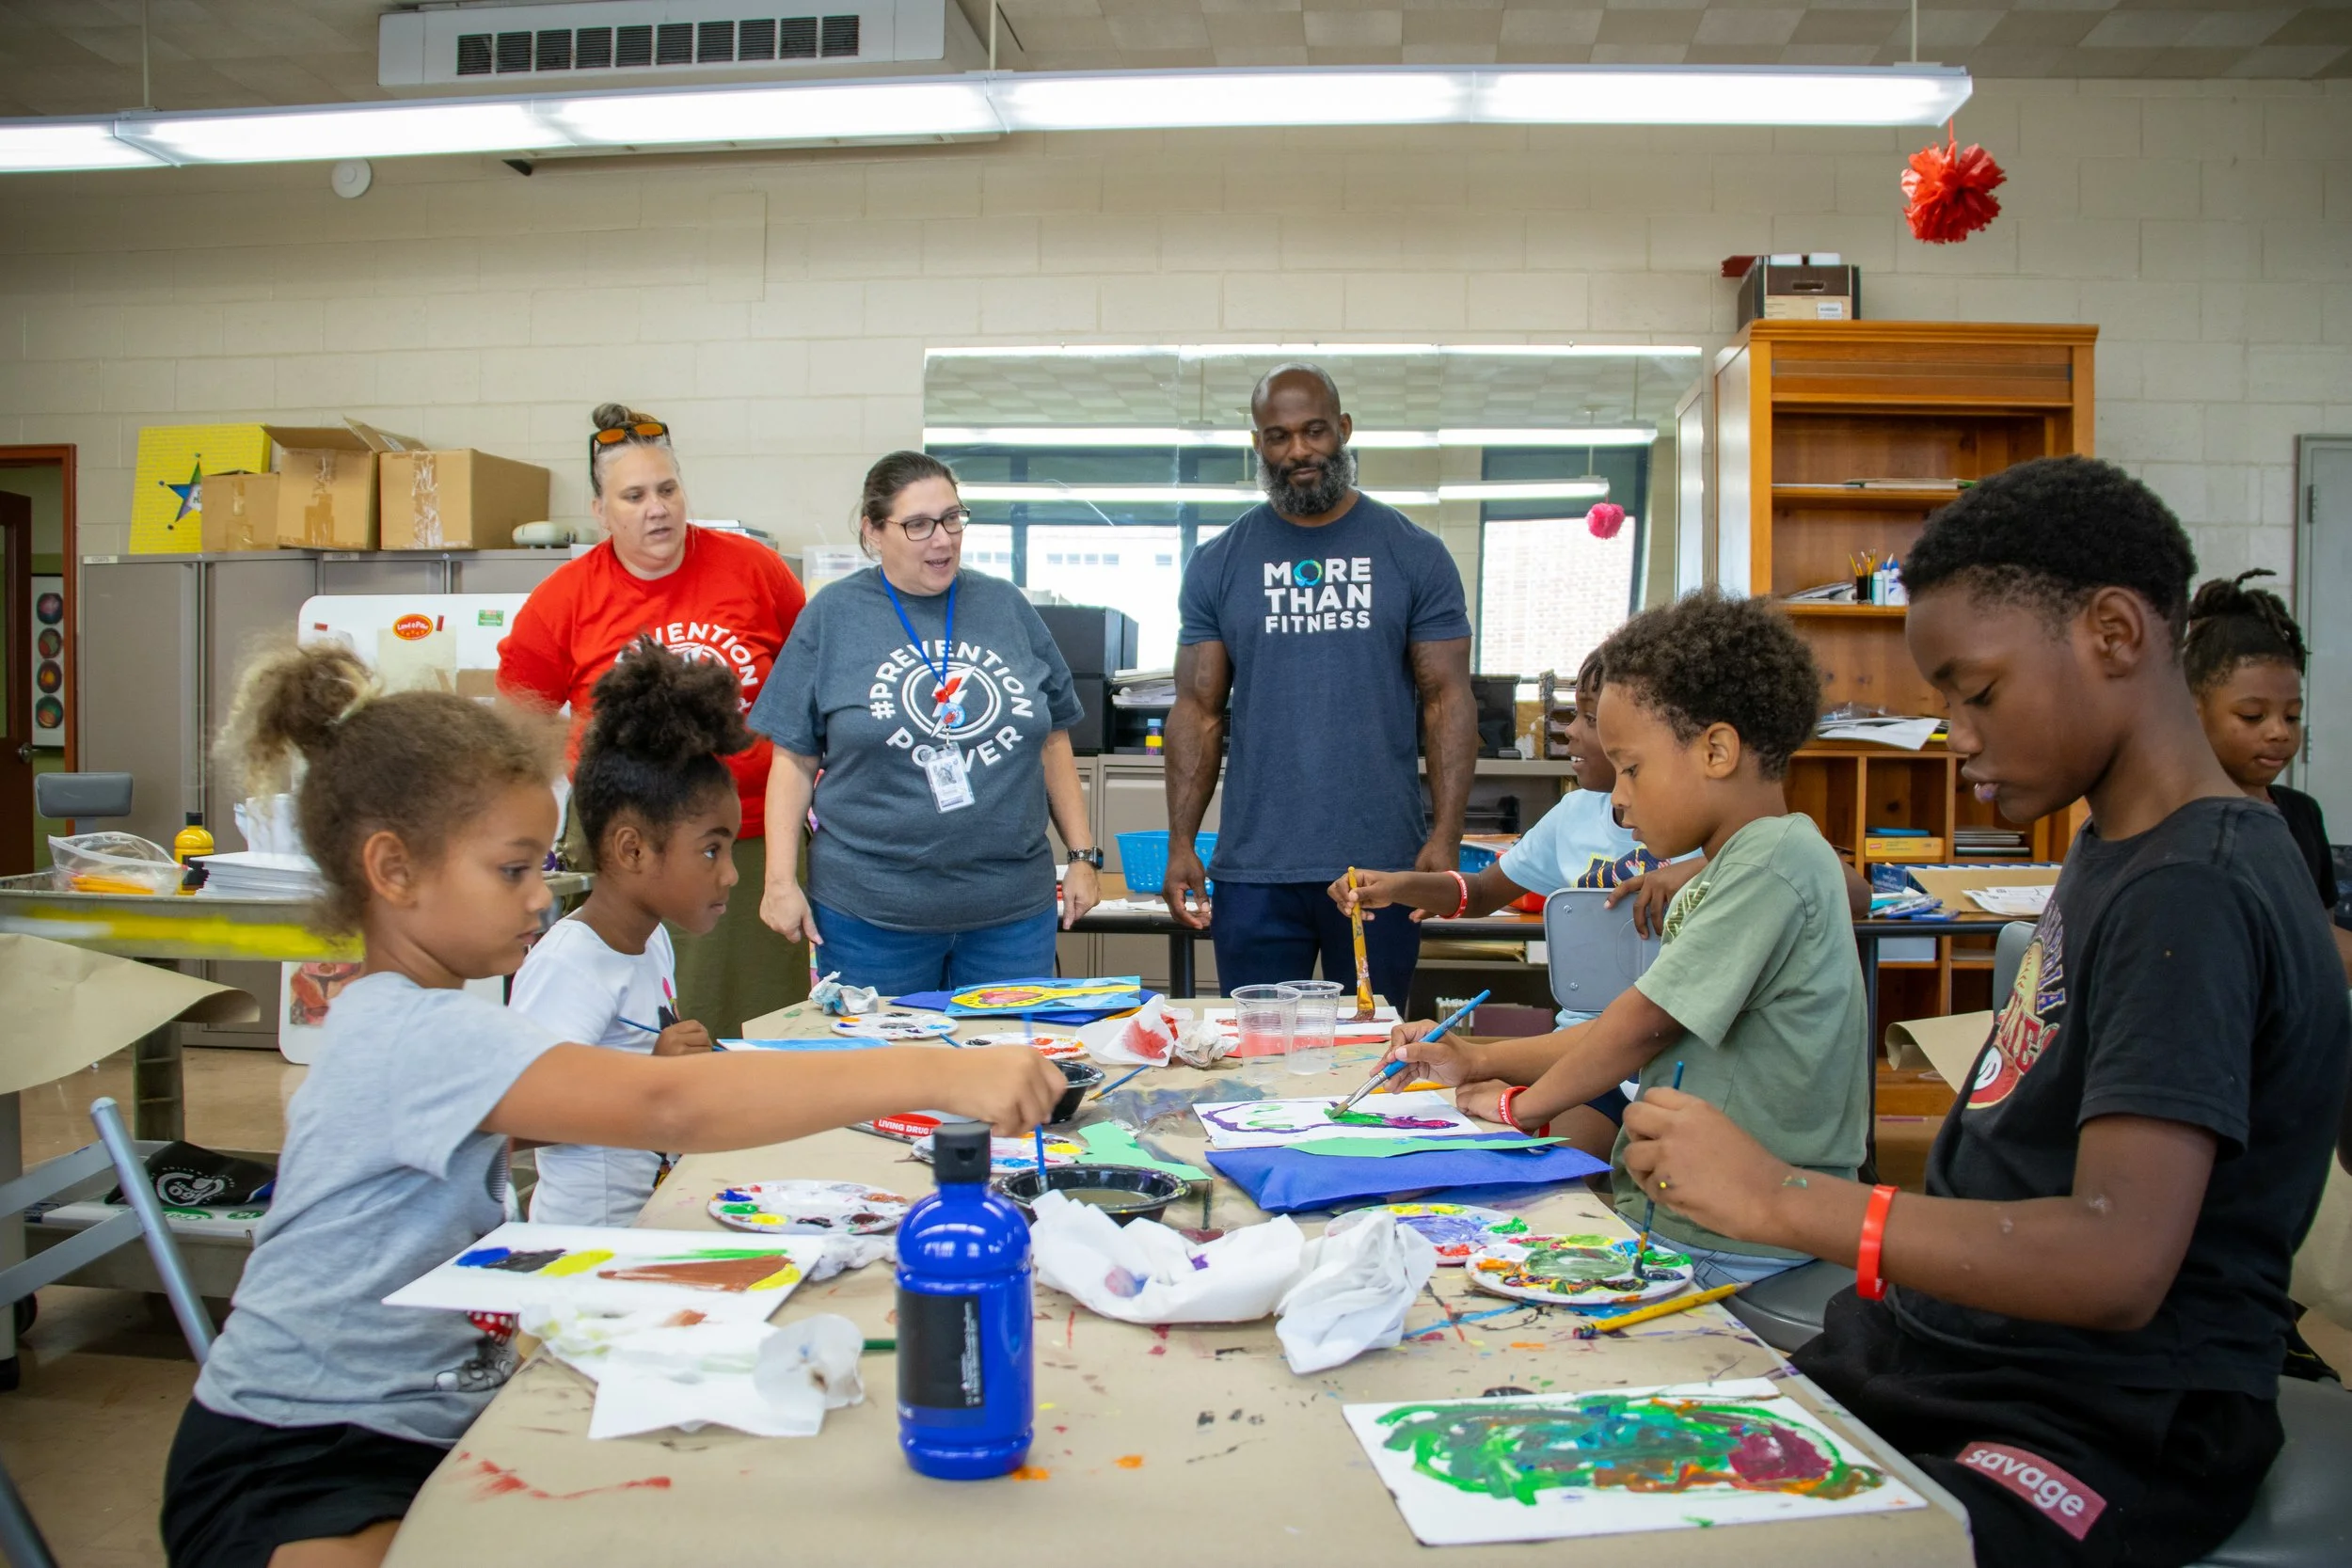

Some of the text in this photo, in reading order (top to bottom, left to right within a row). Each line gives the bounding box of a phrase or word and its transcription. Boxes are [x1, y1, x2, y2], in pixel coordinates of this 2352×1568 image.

[1263, 557, 1372, 587] MORE
[1263, 583, 1372, 613] THAN
[1265, 610, 1371, 634] FITNESS
[878, 1118, 905, 1132] LIVING
[906, 1124, 930, 1134] DRUG
[1965, 1449, 2086, 1517] savage
